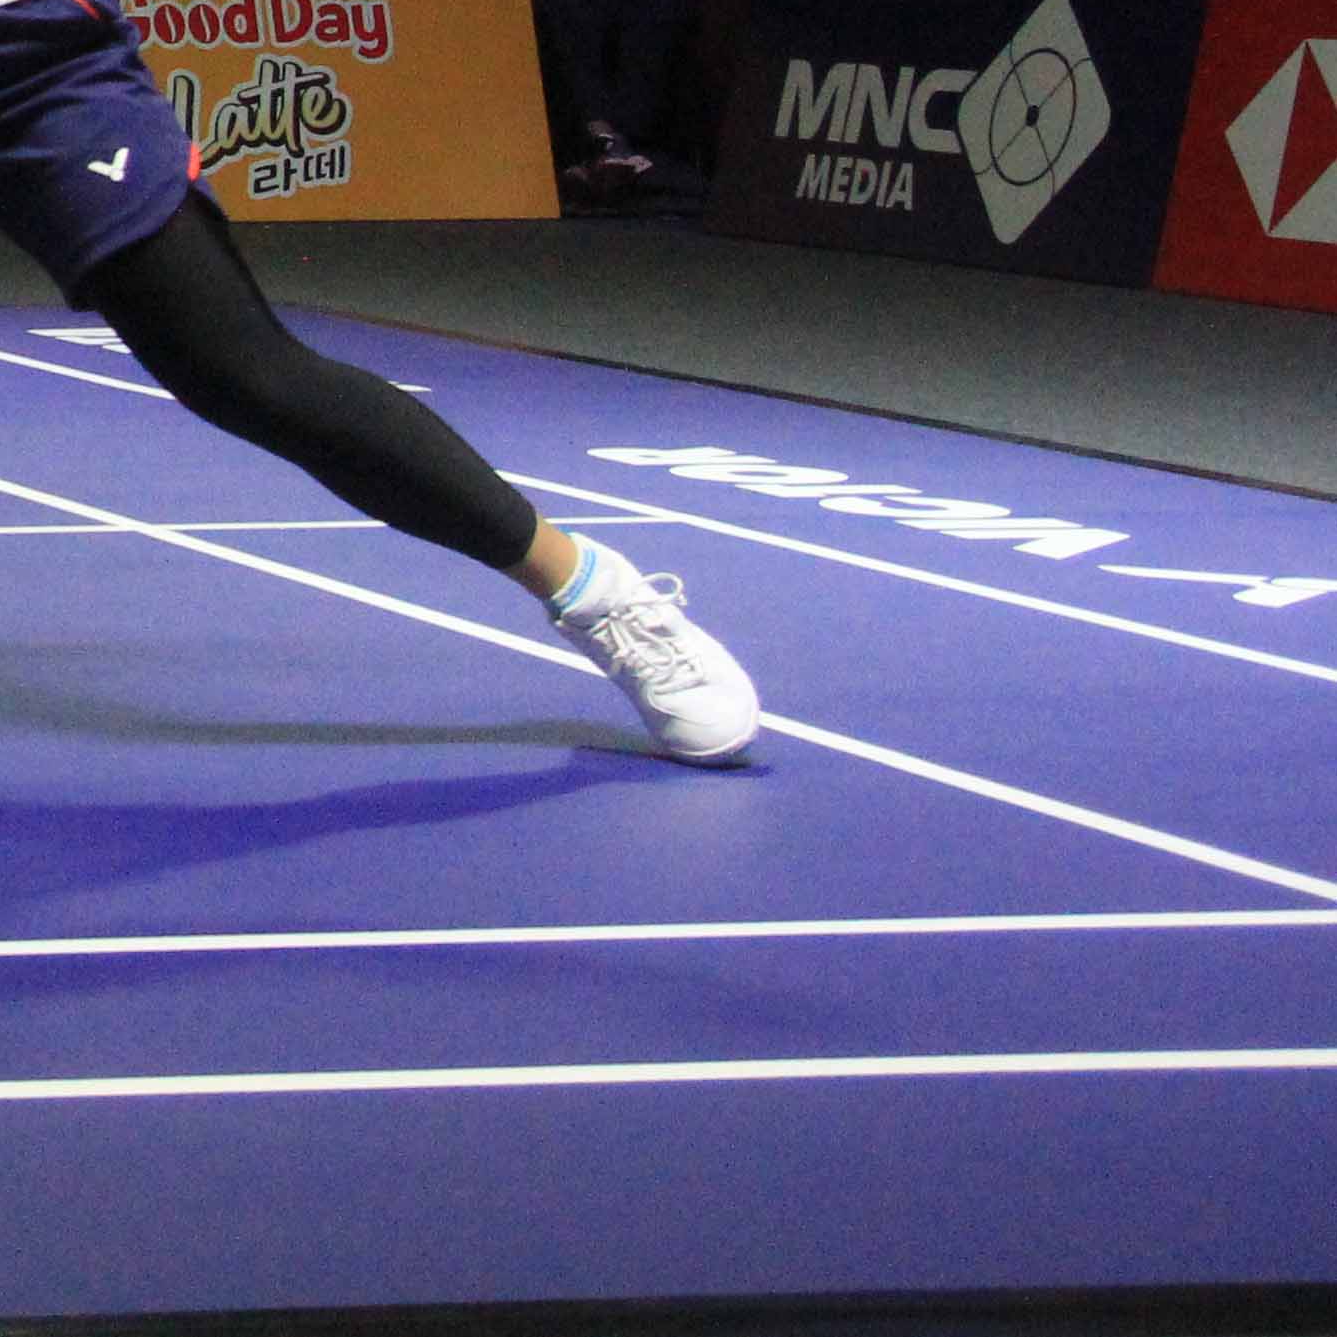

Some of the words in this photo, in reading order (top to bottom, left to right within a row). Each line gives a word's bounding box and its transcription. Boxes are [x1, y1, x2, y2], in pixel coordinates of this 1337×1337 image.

[170, 57, 348, 171] Latte
[774, 59, 981, 155] MNC
[796, 153, 915, 211] MEDIA
